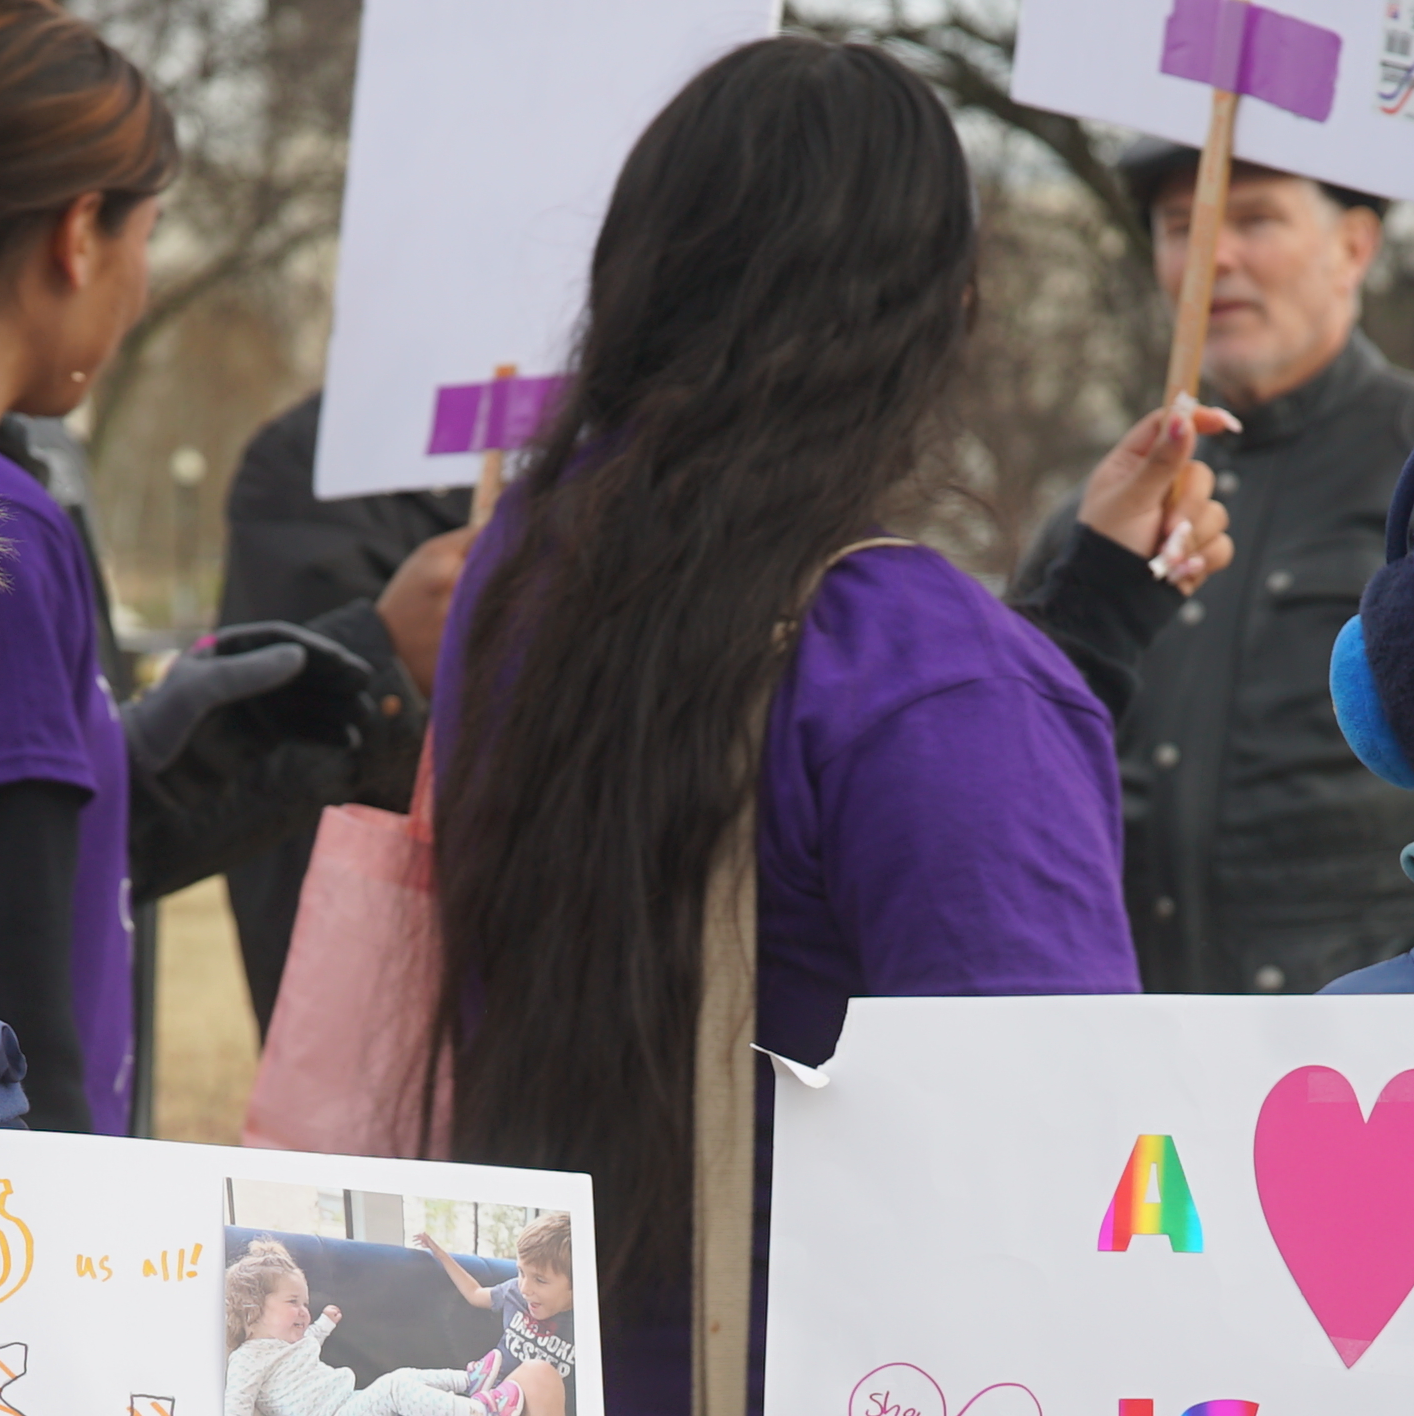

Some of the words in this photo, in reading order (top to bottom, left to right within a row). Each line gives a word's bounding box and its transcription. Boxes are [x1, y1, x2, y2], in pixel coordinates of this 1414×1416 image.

[1097, 1134, 1204, 1254] A
[76, 1254, 113, 1282] us
[142, 1243, 203, 1282] all!
